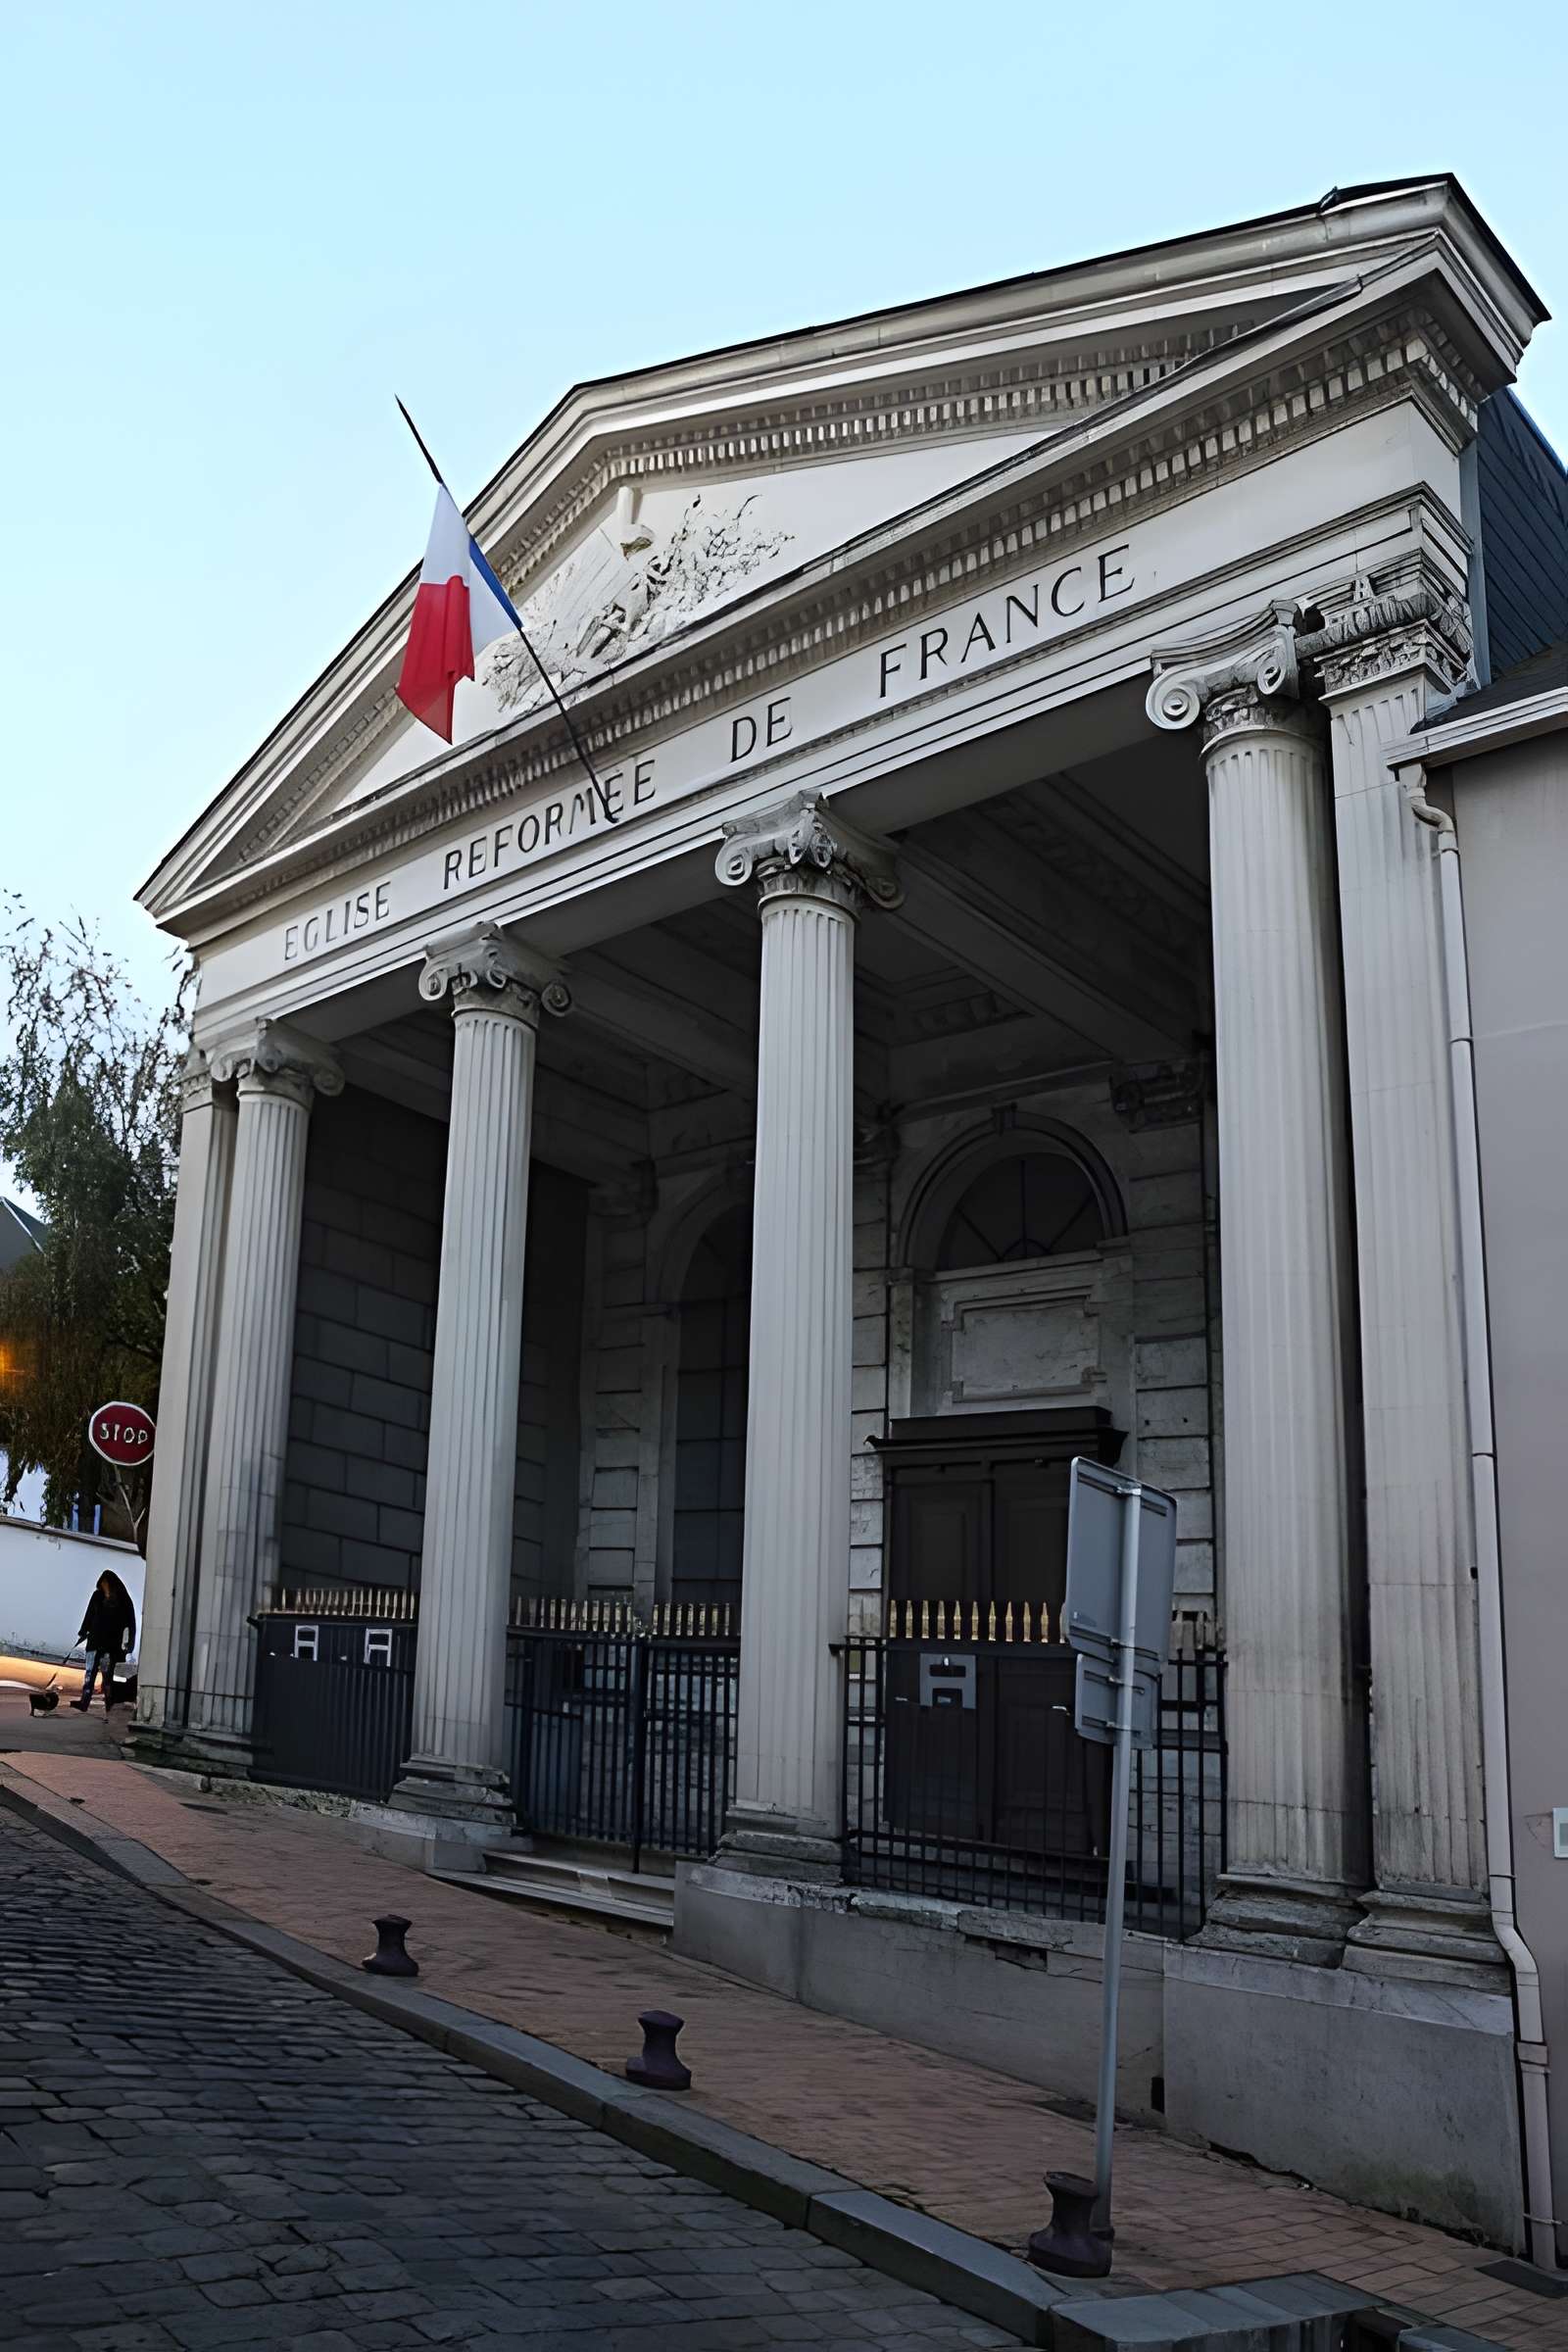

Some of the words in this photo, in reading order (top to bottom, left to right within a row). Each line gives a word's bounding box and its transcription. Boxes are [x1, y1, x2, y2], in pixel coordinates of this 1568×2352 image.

[284, 881, 391, 960] EGLISE
[730, 697, 792, 762] DE
[880, 544, 1135, 698] FRANCE
[100, 1422, 148, 1445] STOP
